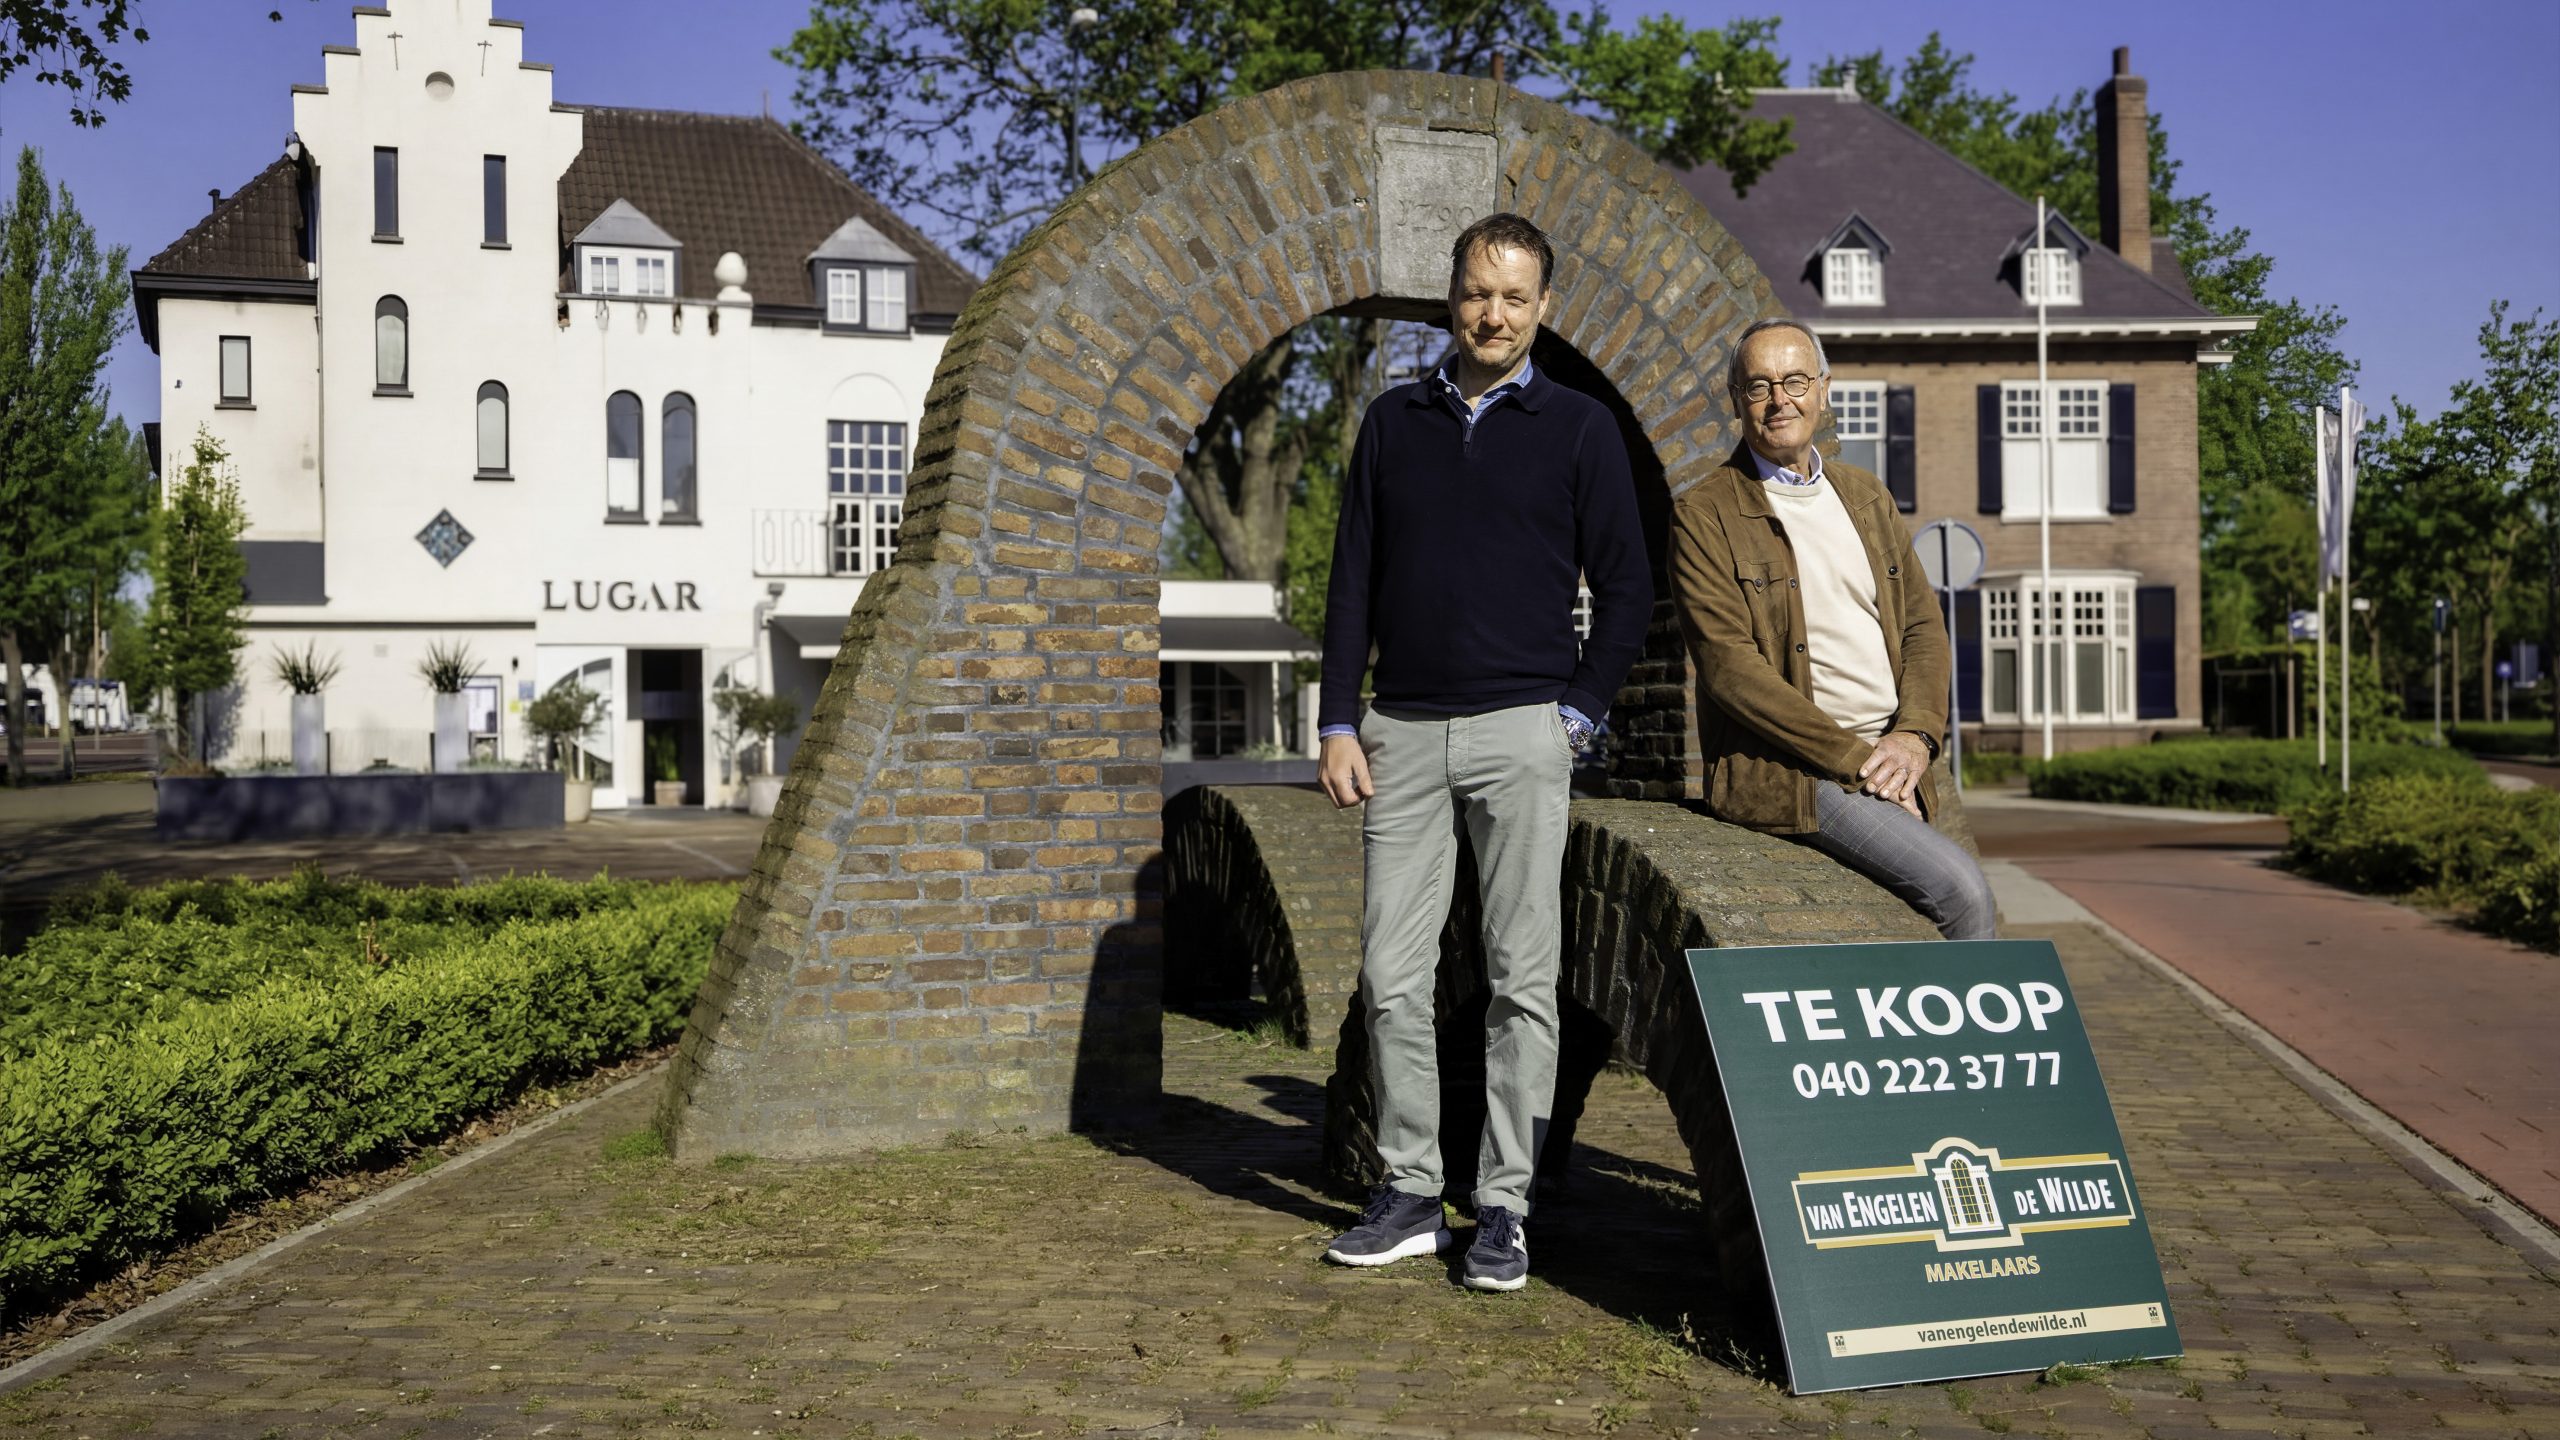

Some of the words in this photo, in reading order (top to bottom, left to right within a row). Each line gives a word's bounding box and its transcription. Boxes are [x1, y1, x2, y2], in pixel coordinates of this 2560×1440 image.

[542, 580, 702, 611] LUGAR
[1742, 991, 1846, 1043] TE
[1856, 981, 2064, 1038] KOOP
[1792, 1060, 1870, 1099] 040
[1877, 1057, 1956, 1094] 222
[1960, 1054, 2006, 1089] 37
[2015, 1051, 2061, 1087] 77
[1806, 1203, 1845, 1231] VAN
[1842, 1191, 1940, 1228] ENGELEN
[2013, 1189, 2040, 1216] DE
[2038, 1177, 2116, 1214] WILDE
[1925, 1255, 2041, 1283] MAKELAARS
[1917, 1312, 2088, 1344] vanengelendewilde.nl
